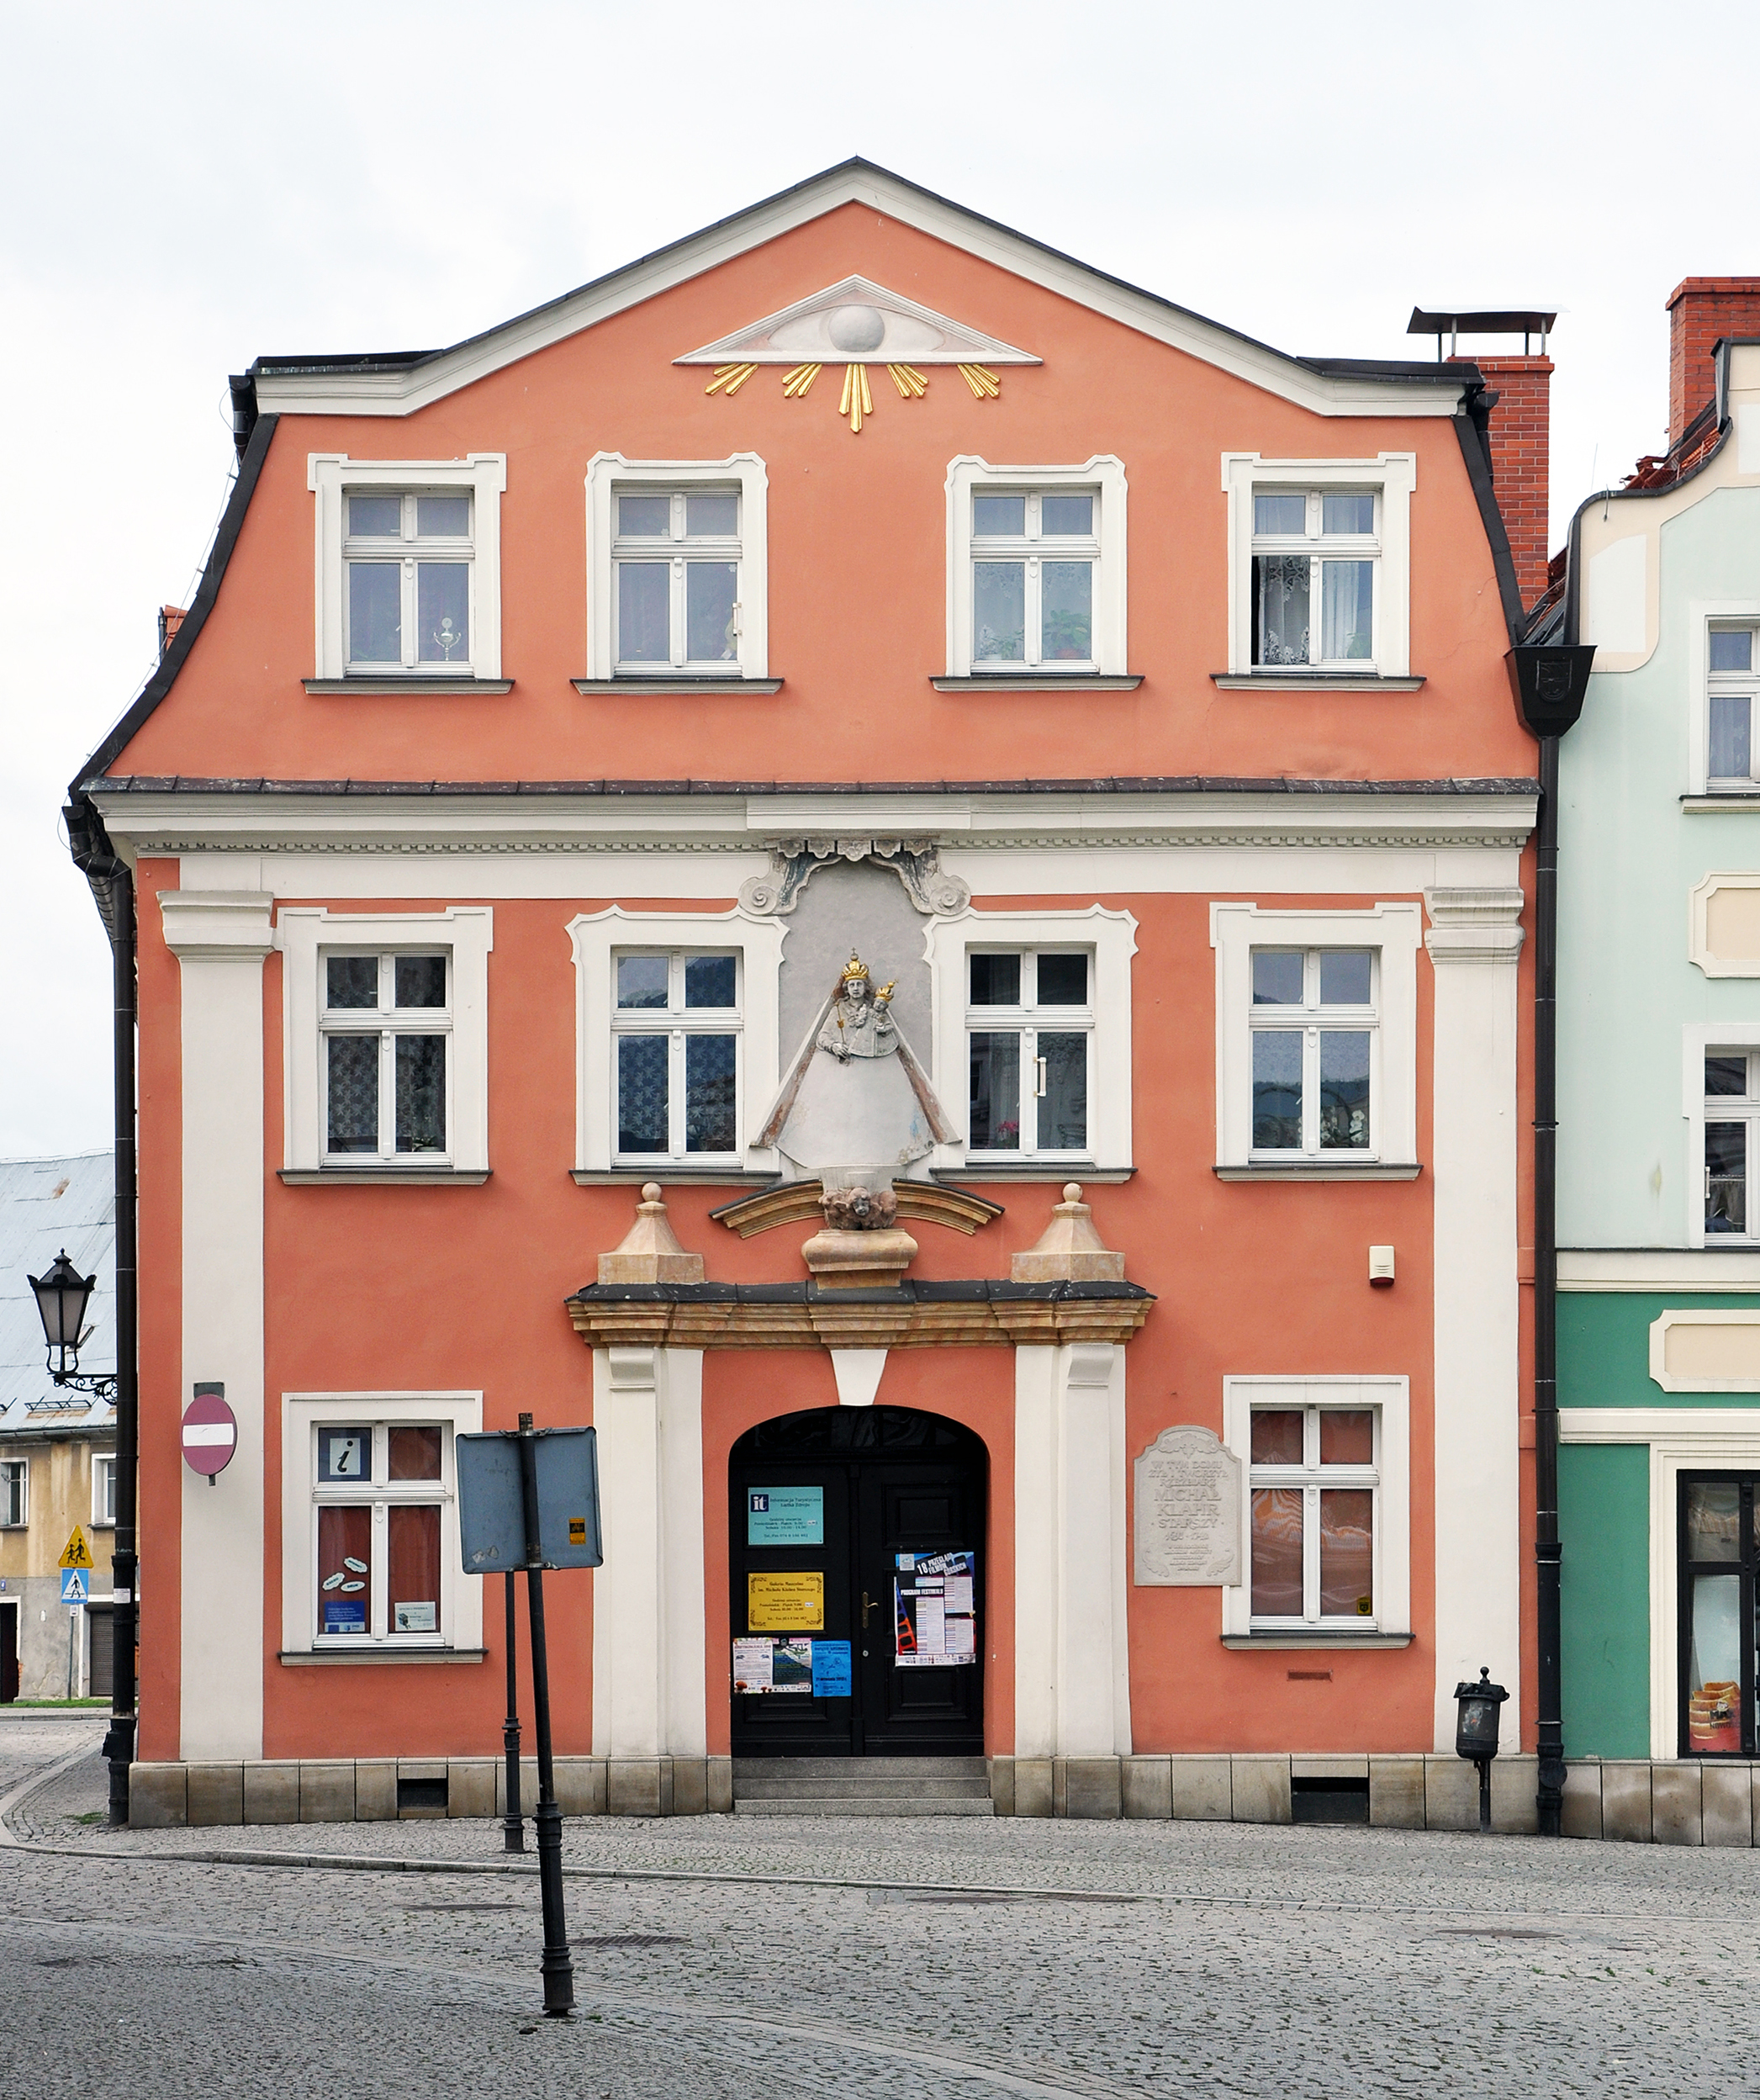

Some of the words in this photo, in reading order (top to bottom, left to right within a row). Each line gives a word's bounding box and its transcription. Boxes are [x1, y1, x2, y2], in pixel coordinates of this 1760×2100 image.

[1154, 1489, 1222, 1501] MICHAŁ
[753, 1496, 767, 1510] it
[1157, 1504, 1221, 1516] KLAHR
[1159, 1518, 1218, 1530] STARSZY
[917, 1562, 928, 1574] 18
